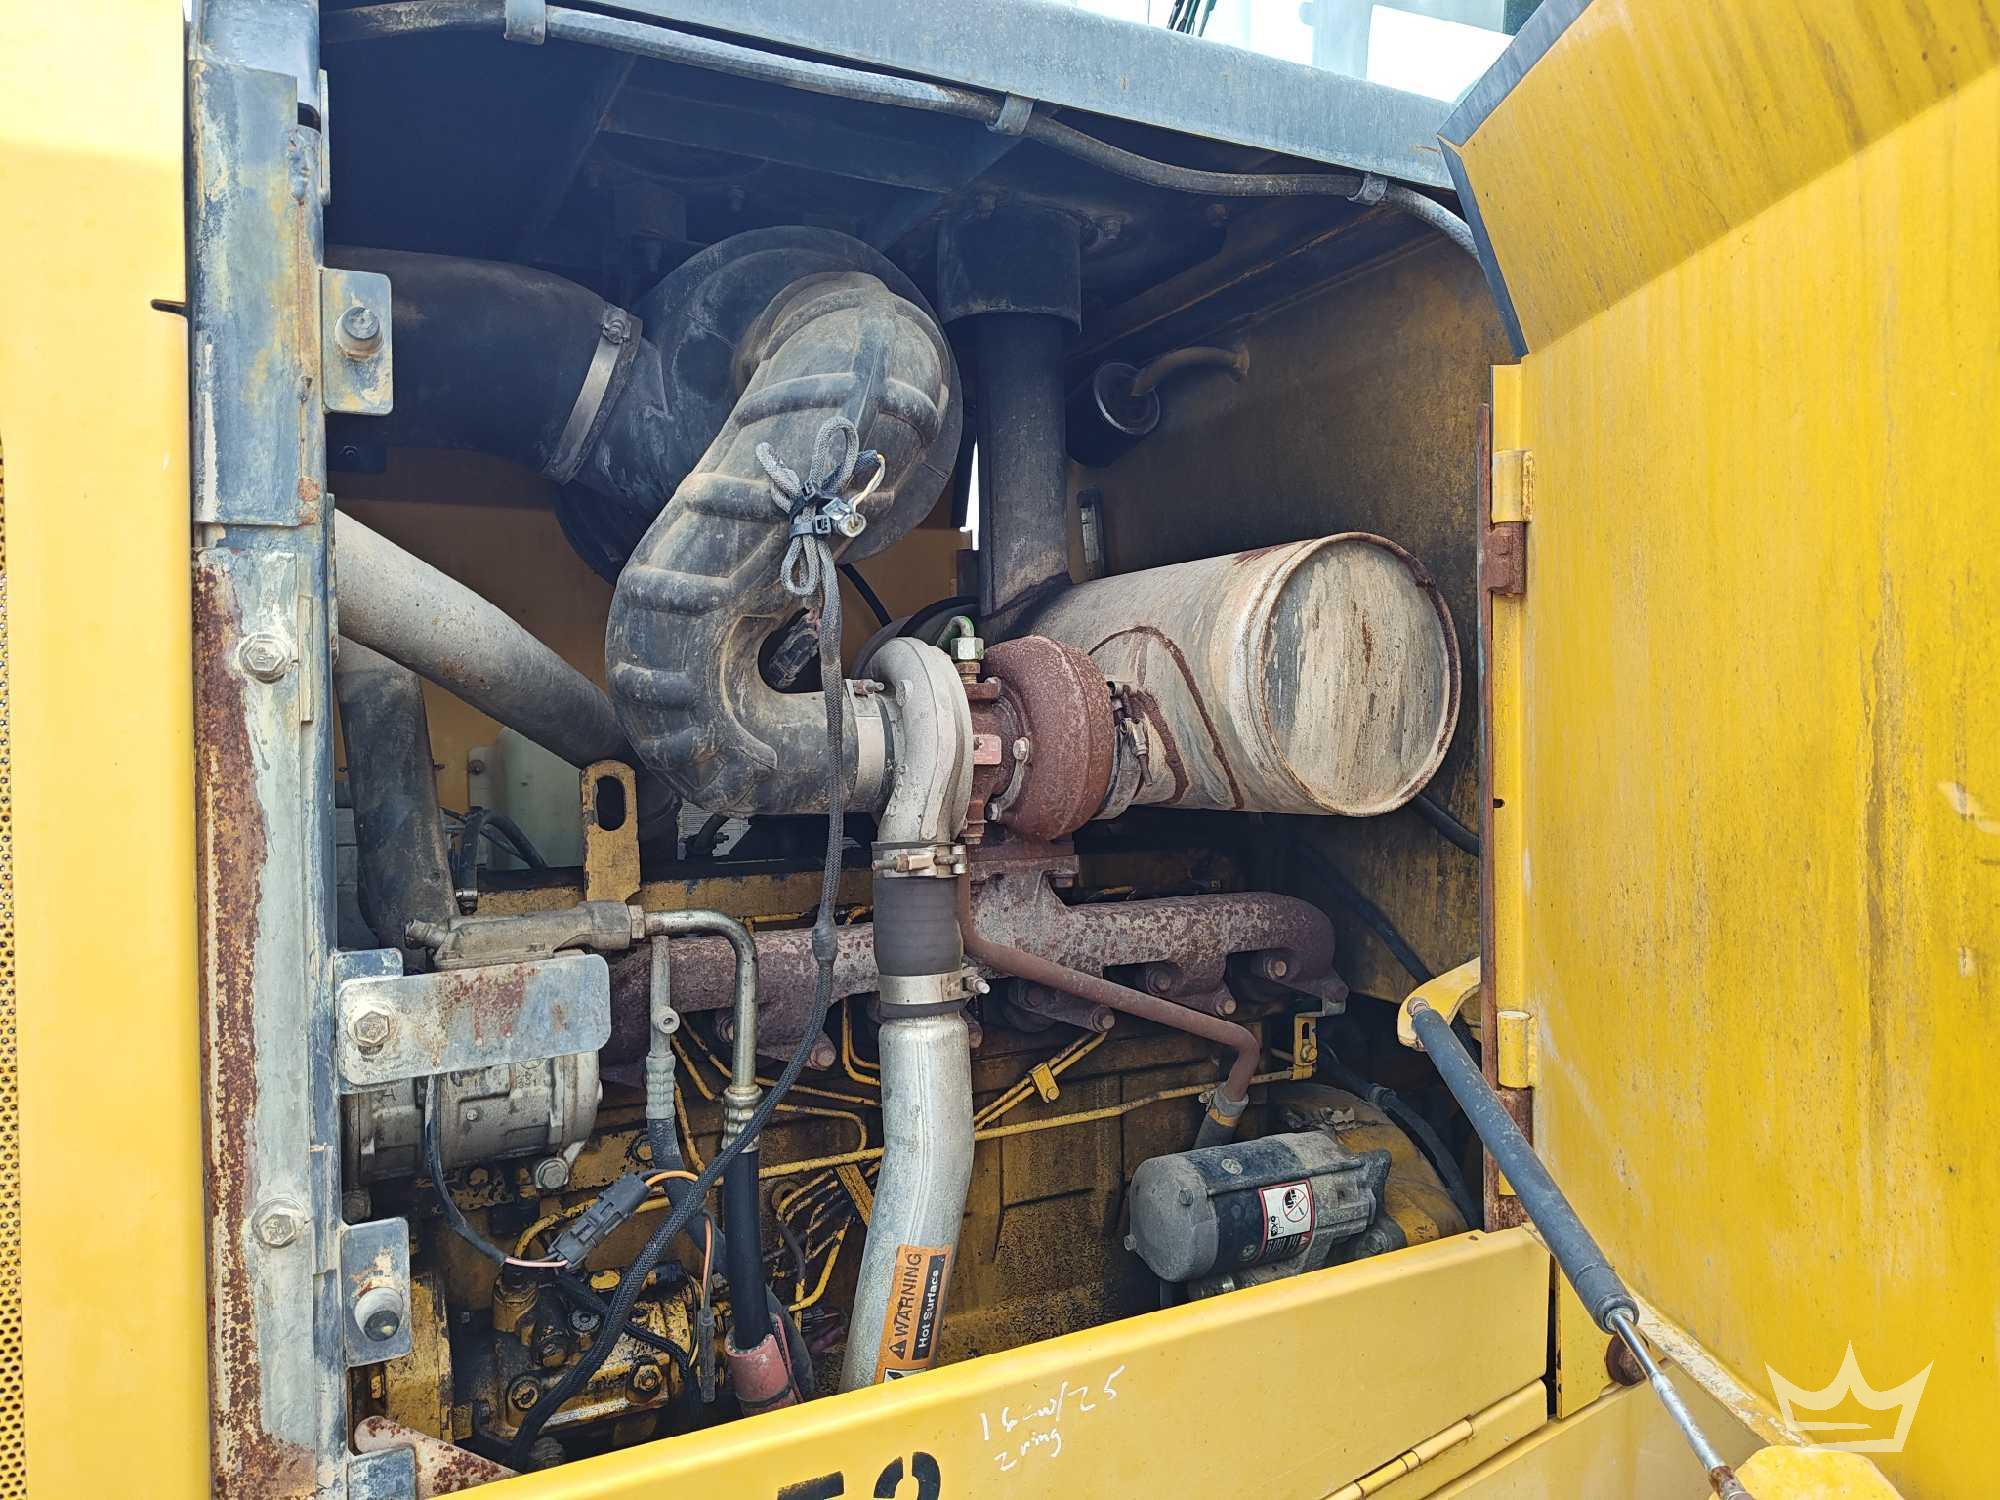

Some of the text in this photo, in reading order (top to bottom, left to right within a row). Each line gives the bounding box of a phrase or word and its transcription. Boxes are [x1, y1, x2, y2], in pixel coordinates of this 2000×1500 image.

[895, 1252, 923, 1336] WARNING
[918, 1270, 939, 1348] Hot Surface
